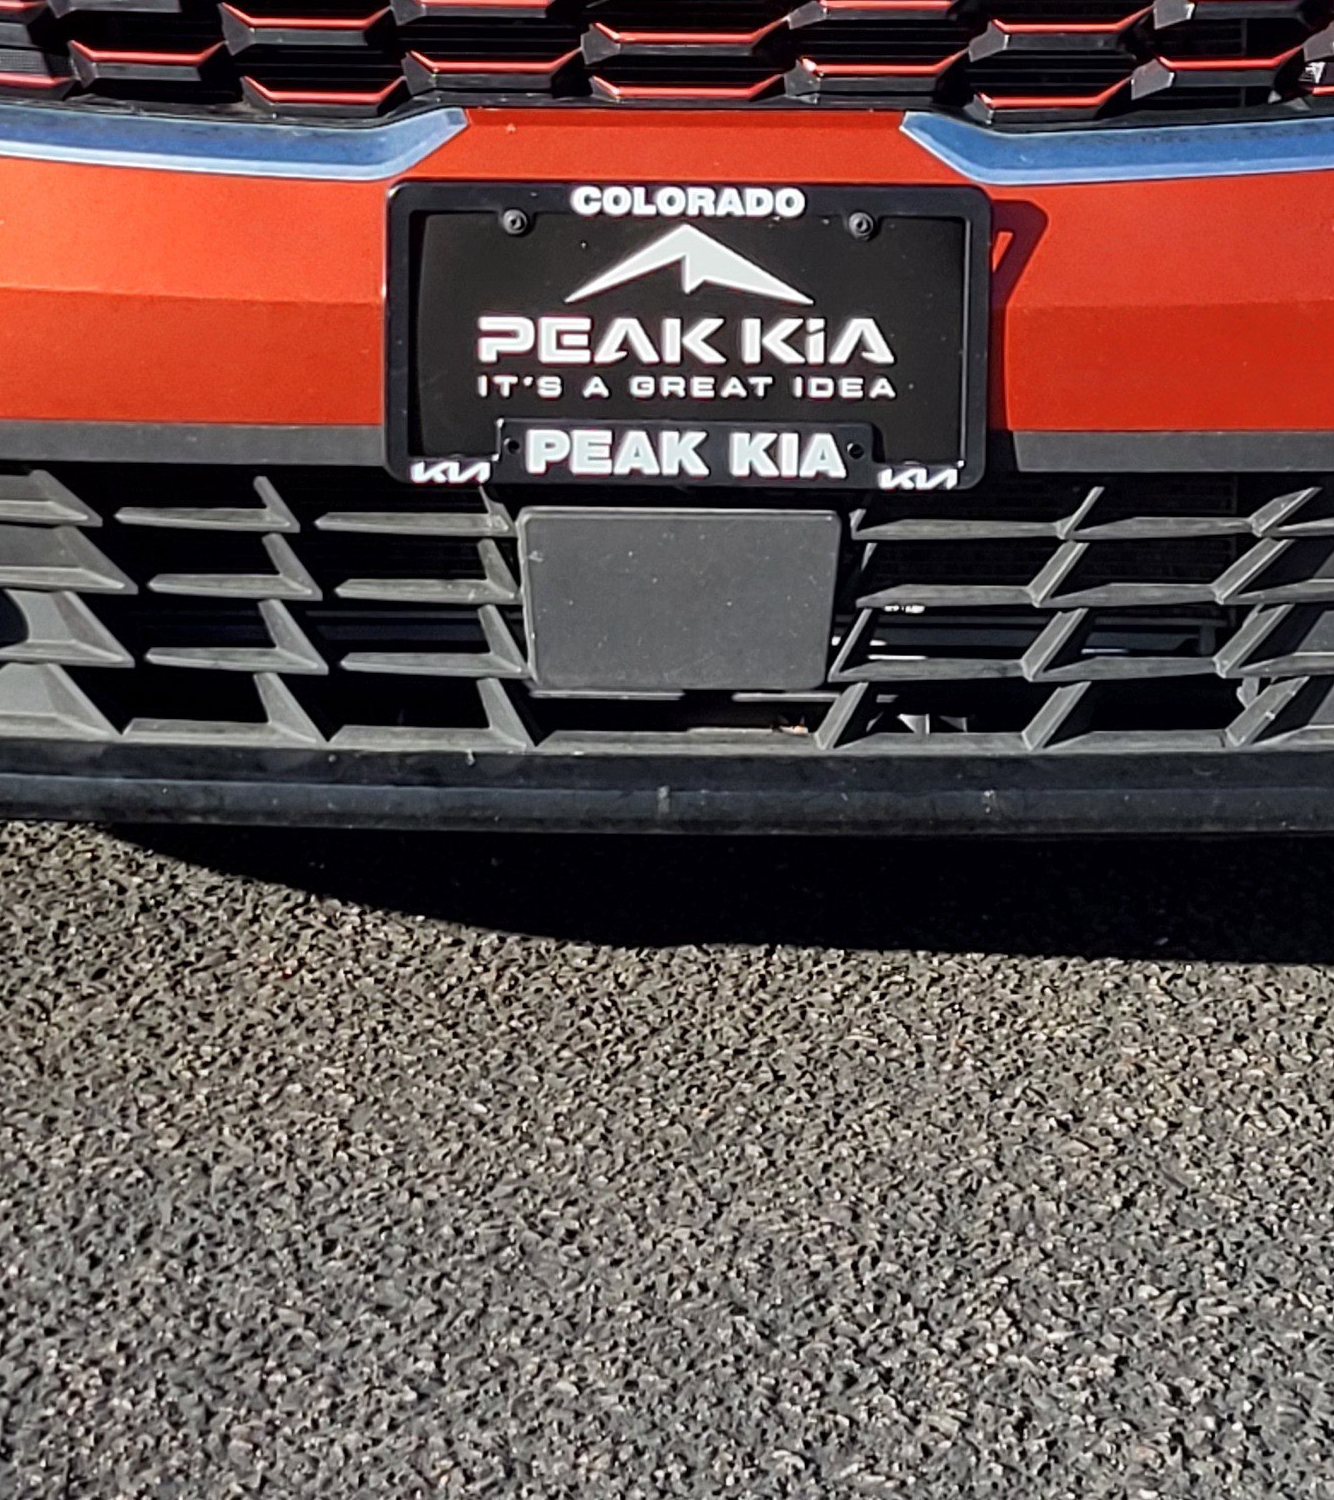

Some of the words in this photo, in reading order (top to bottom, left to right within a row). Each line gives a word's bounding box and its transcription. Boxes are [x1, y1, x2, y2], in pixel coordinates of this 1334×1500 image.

[570, 185, 806, 218] COLORADO
[477, 315, 727, 365] PEAK
[477, 376, 562, 399] IT'S
[582, 377, 610, 399] A
[629, 376, 773, 399] GREAT
[793, 377, 896, 399] IDEA
[525, 429, 710, 477] PEAK
[729, 432, 847, 480] KIA
[410, 461, 491, 484] KIA
[877, 466, 960, 491] KIA
